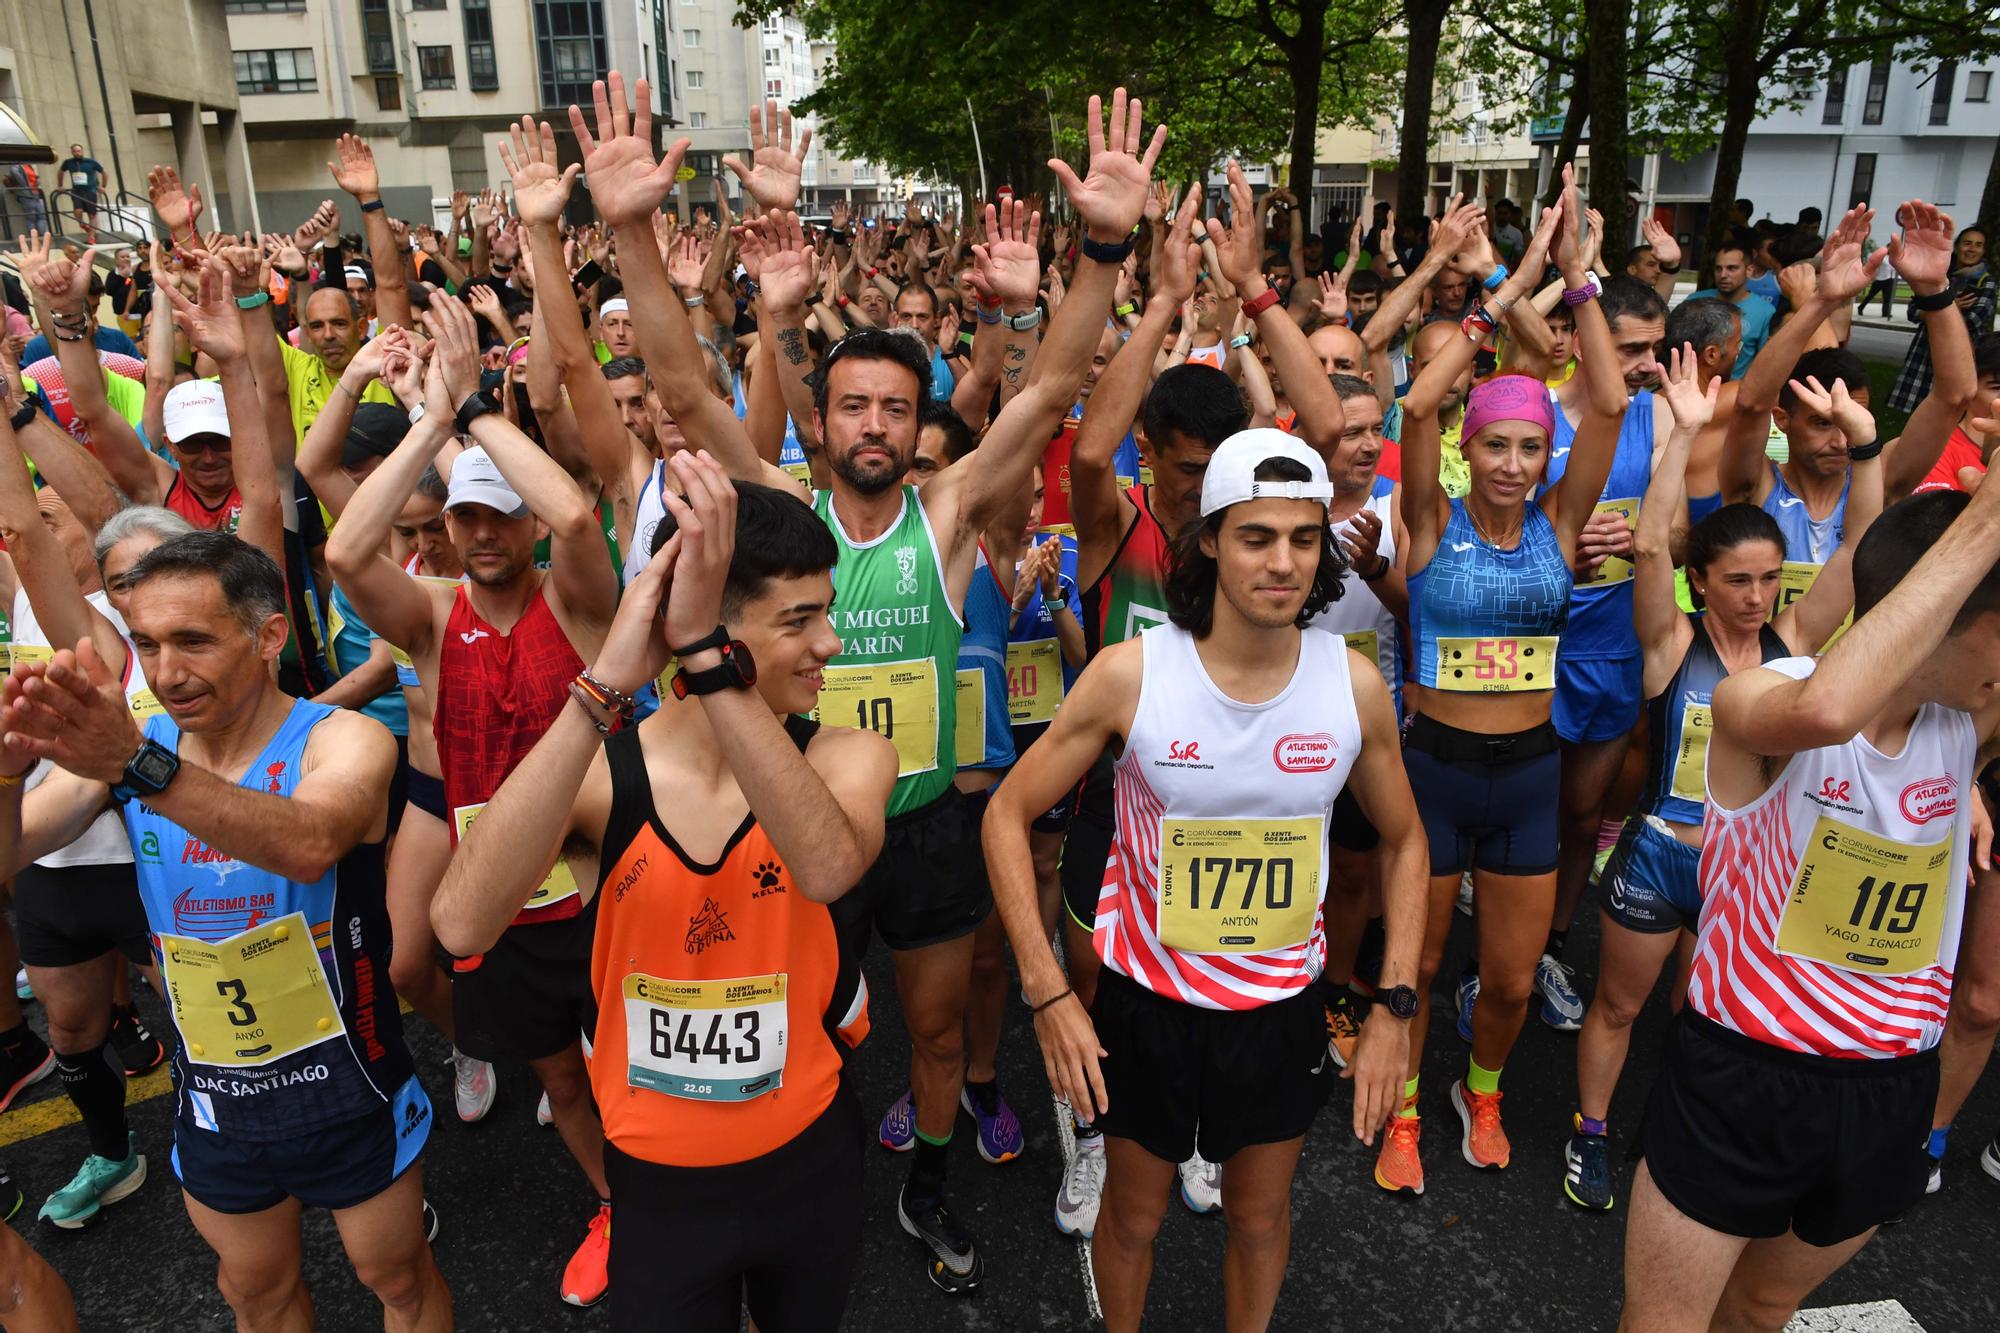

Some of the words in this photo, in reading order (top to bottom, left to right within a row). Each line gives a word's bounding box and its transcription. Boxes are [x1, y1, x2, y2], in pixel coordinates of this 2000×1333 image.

[840, 631, 904, 656] ARÍN
[1475, 639, 1518, 679] 53
[856, 697, 893, 740] 10
[1287, 742, 1328, 752] ATLETISMO
[1683, 737, 1692, 759] TANDA
[1154, 760, 1186, 769] Orientación
[1287, 755, 1326, 765] SANTIAGO
[1187, 828, 1242, 837] CORUÑACORRE
[1842, 836, 1909, 862] CORUÑACORRE
[1845, 851, 1871, 864] EDICIÓN
[615, 853, 649, 903] GRAVITY
[1165, 864, 1173, 897] TANDA
[1188, 857, 1294, 910] 1770
[1796, 864, 1815, 898] TANDA
[183, 896, 246, 912] ATLETISMO
[250, 892, 275, 907] SAR
[1849, 875, 1929, 933] 119
[1221, 915, 1259, 927] ANTÓN
[242, 948, 257, 958] DOS
[258, 936, 289, 953] BARRIOS
[247, 937, 270, 951] XENTE
[1824, 924, 1860, 943] YAGO
[1866, 937, 1922, 949] IGNACIO
[171, 981, 182, 1013] TANDA
[726, 991, 741, 999] DOS
[742, 988, 772, 998] BARRIOS
[733, 984, 755, 992] XENTE
[216, 978, 257, 1026] 3
[235, 1028, 265, 1041] ANXO
[650, 1007, 761, 1065] 6443
[194, 1075, 229, 1093] DAC
[231, 1064, 329, 1097] SANTIAGO
[683, 1083, 713, 1094] 22.05
